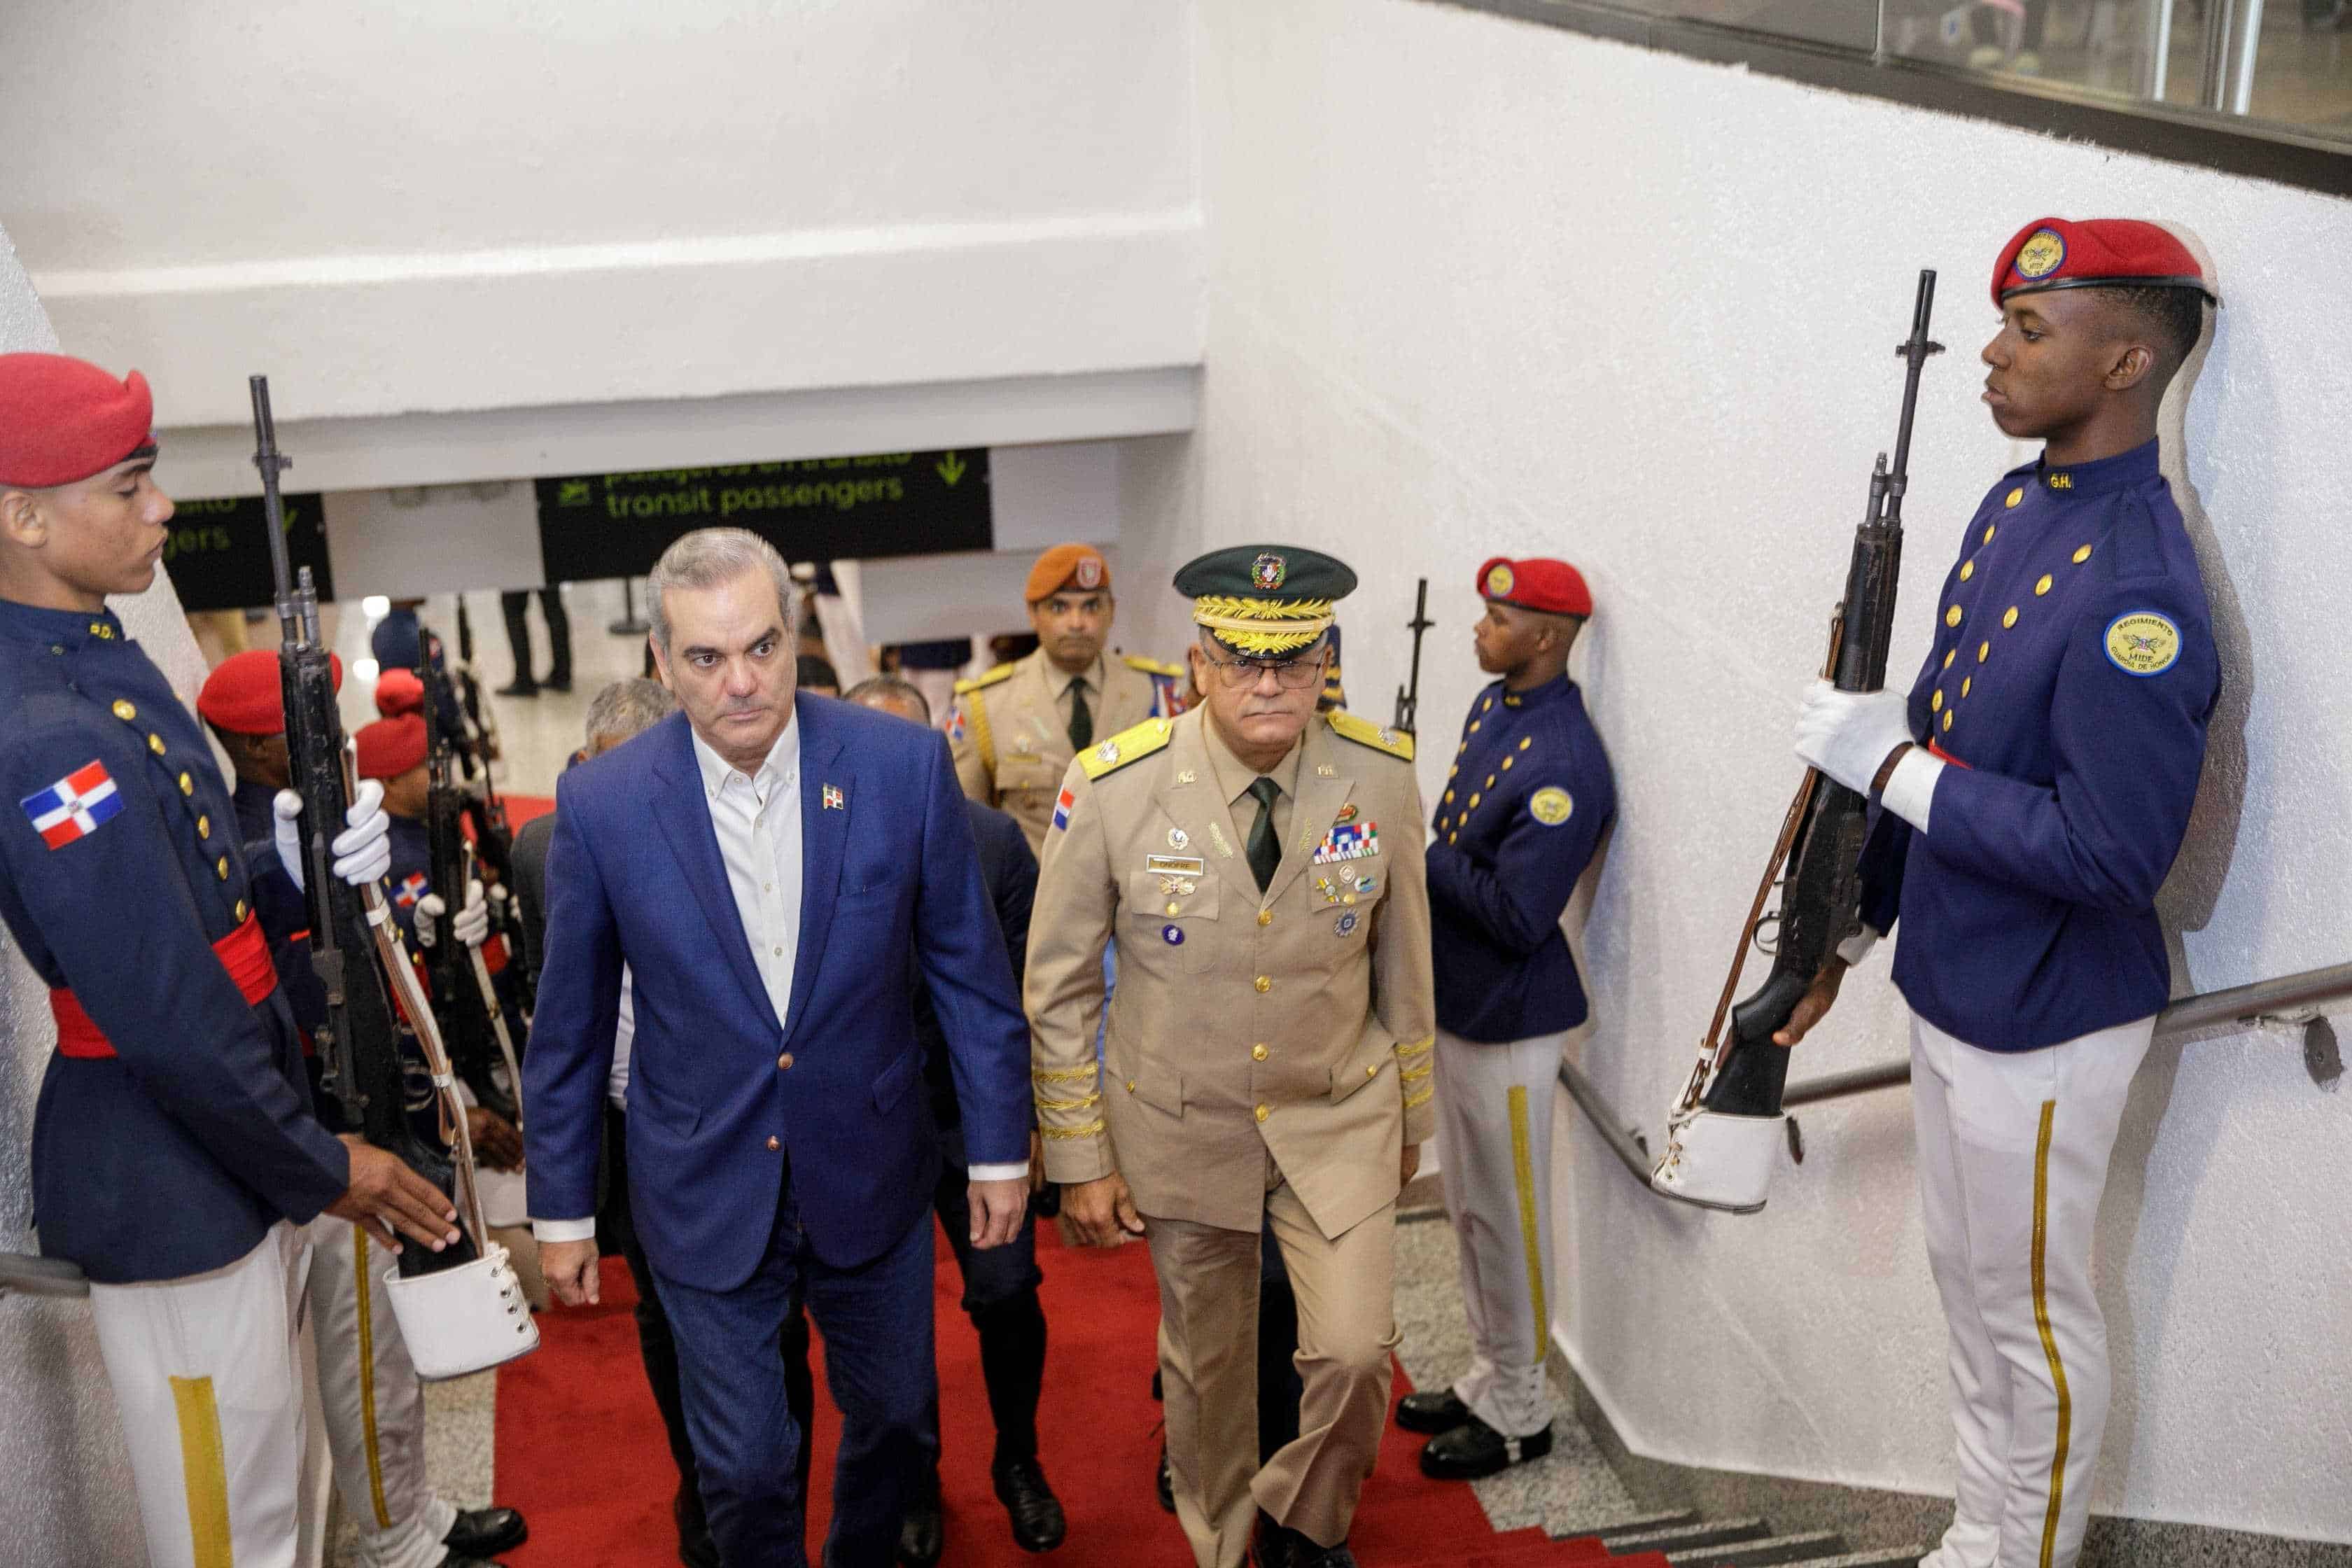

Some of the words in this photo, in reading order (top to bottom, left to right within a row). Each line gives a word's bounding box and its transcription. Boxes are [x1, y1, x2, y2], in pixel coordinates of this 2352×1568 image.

[605, 484, 711, 517] transit
[720, 477, 904, 517] passengers
[2117, 617, 2174, 636] REGIMIENTO
[2110, 645, 2135, 668] GUARDIA
[2128, 653, 2154, 662] MIDE
